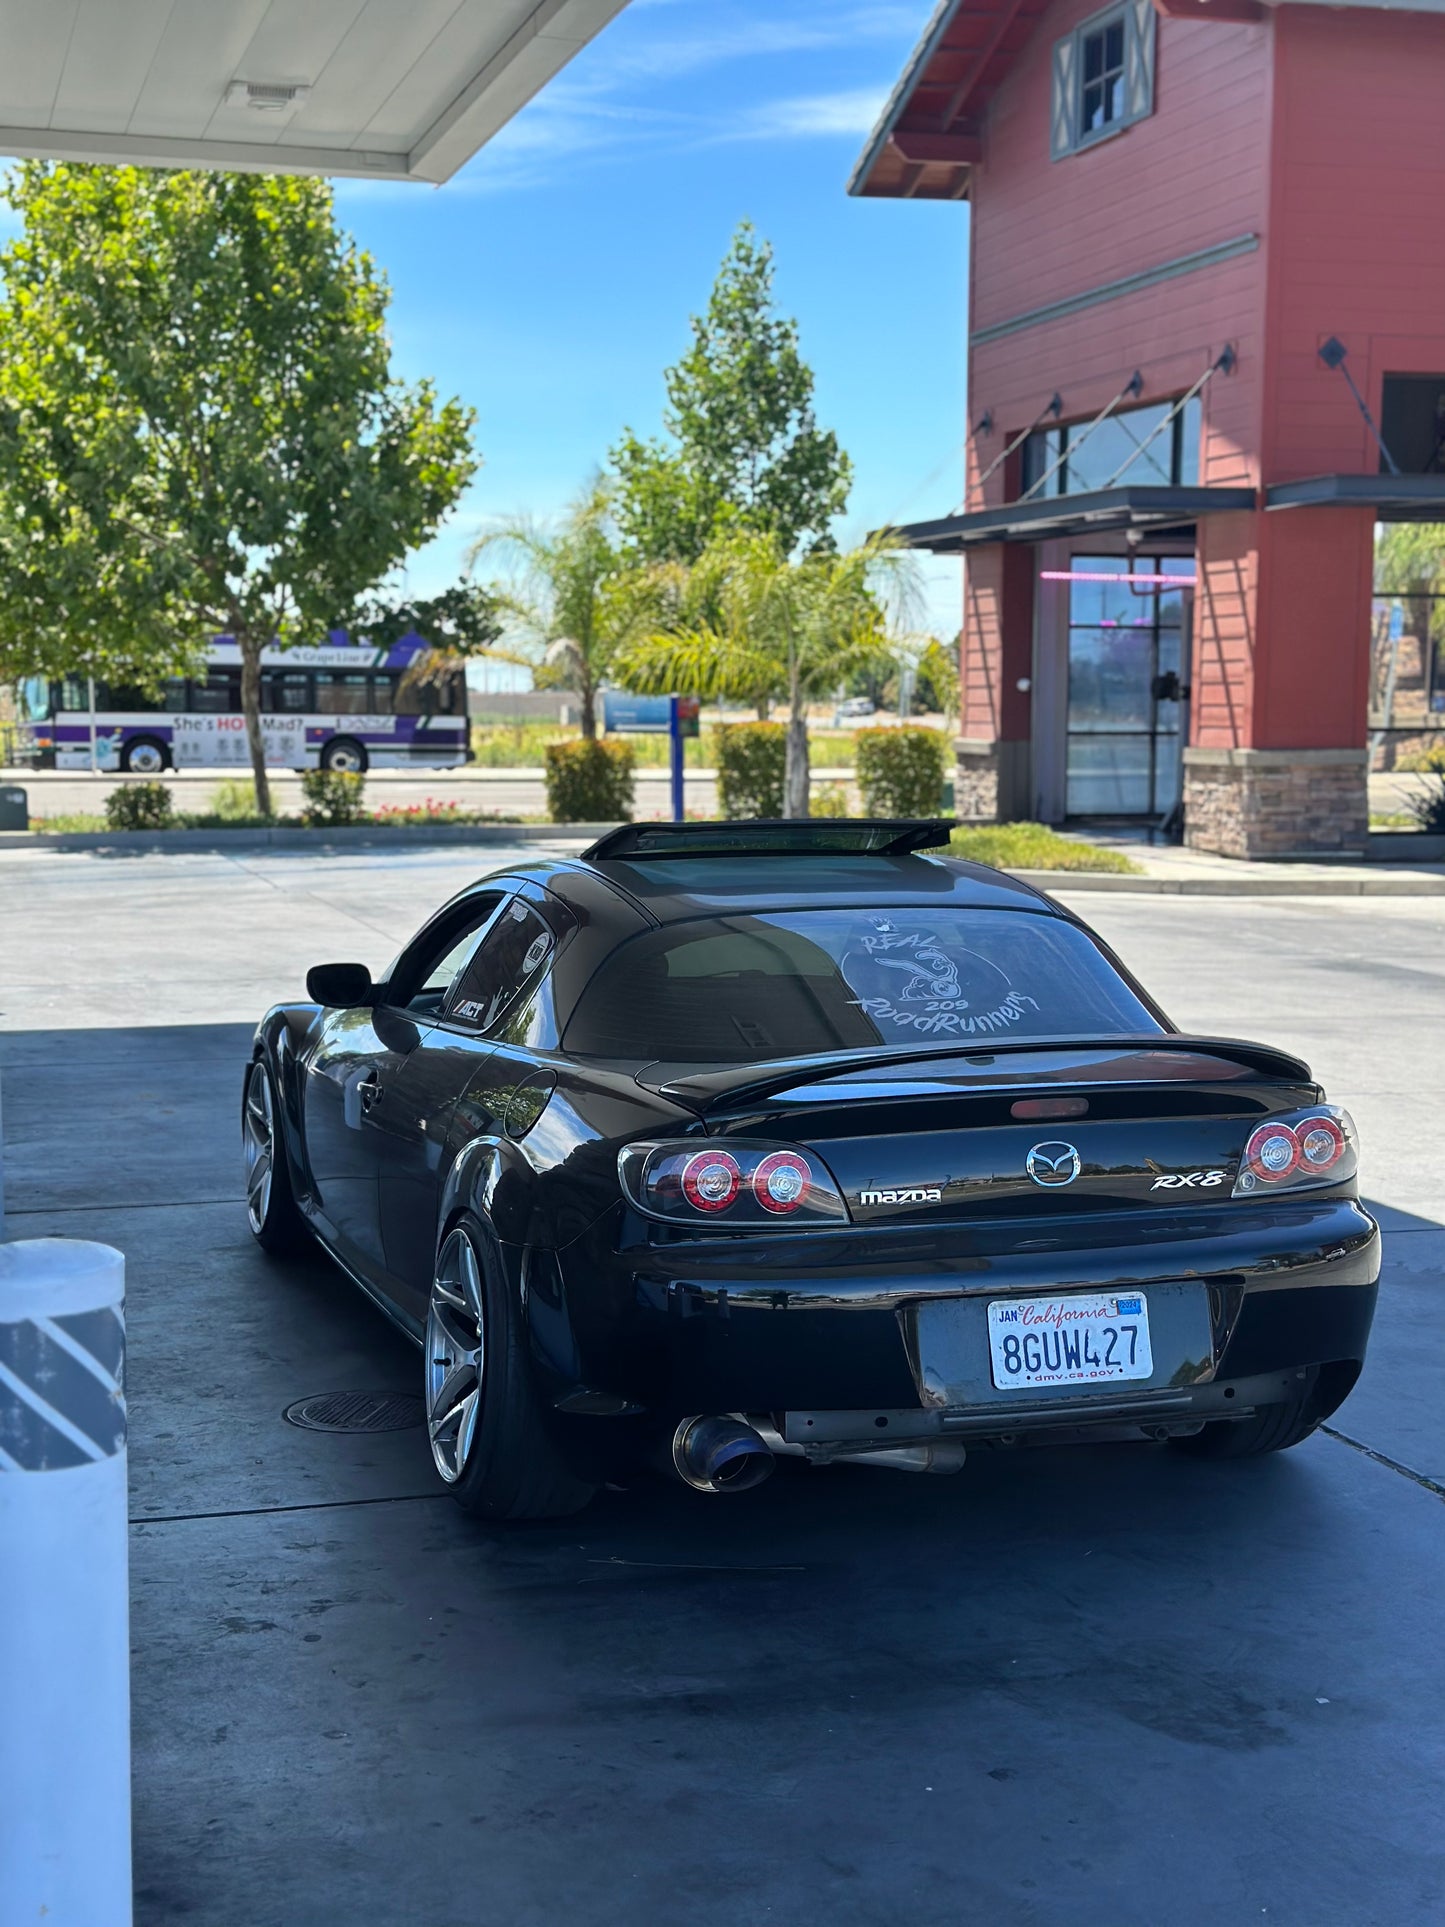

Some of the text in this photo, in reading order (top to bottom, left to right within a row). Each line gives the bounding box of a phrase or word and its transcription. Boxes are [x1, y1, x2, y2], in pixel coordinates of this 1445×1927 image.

[174, 716, 303, 731] She's HO Mad?
[861, 933, 941, 954] REAL
[924, 1000, 969, 1011] 209
[1150, 1170, 1226, 1192] RX-8
[999, 1309, 1018, 1323] JAN
[1022, 1304, 1117, 1329] California
[1003, 1325, 1137, 1374] 8GUW427
[1034, 1368, 1114, 1382] dmv.ca.gov
